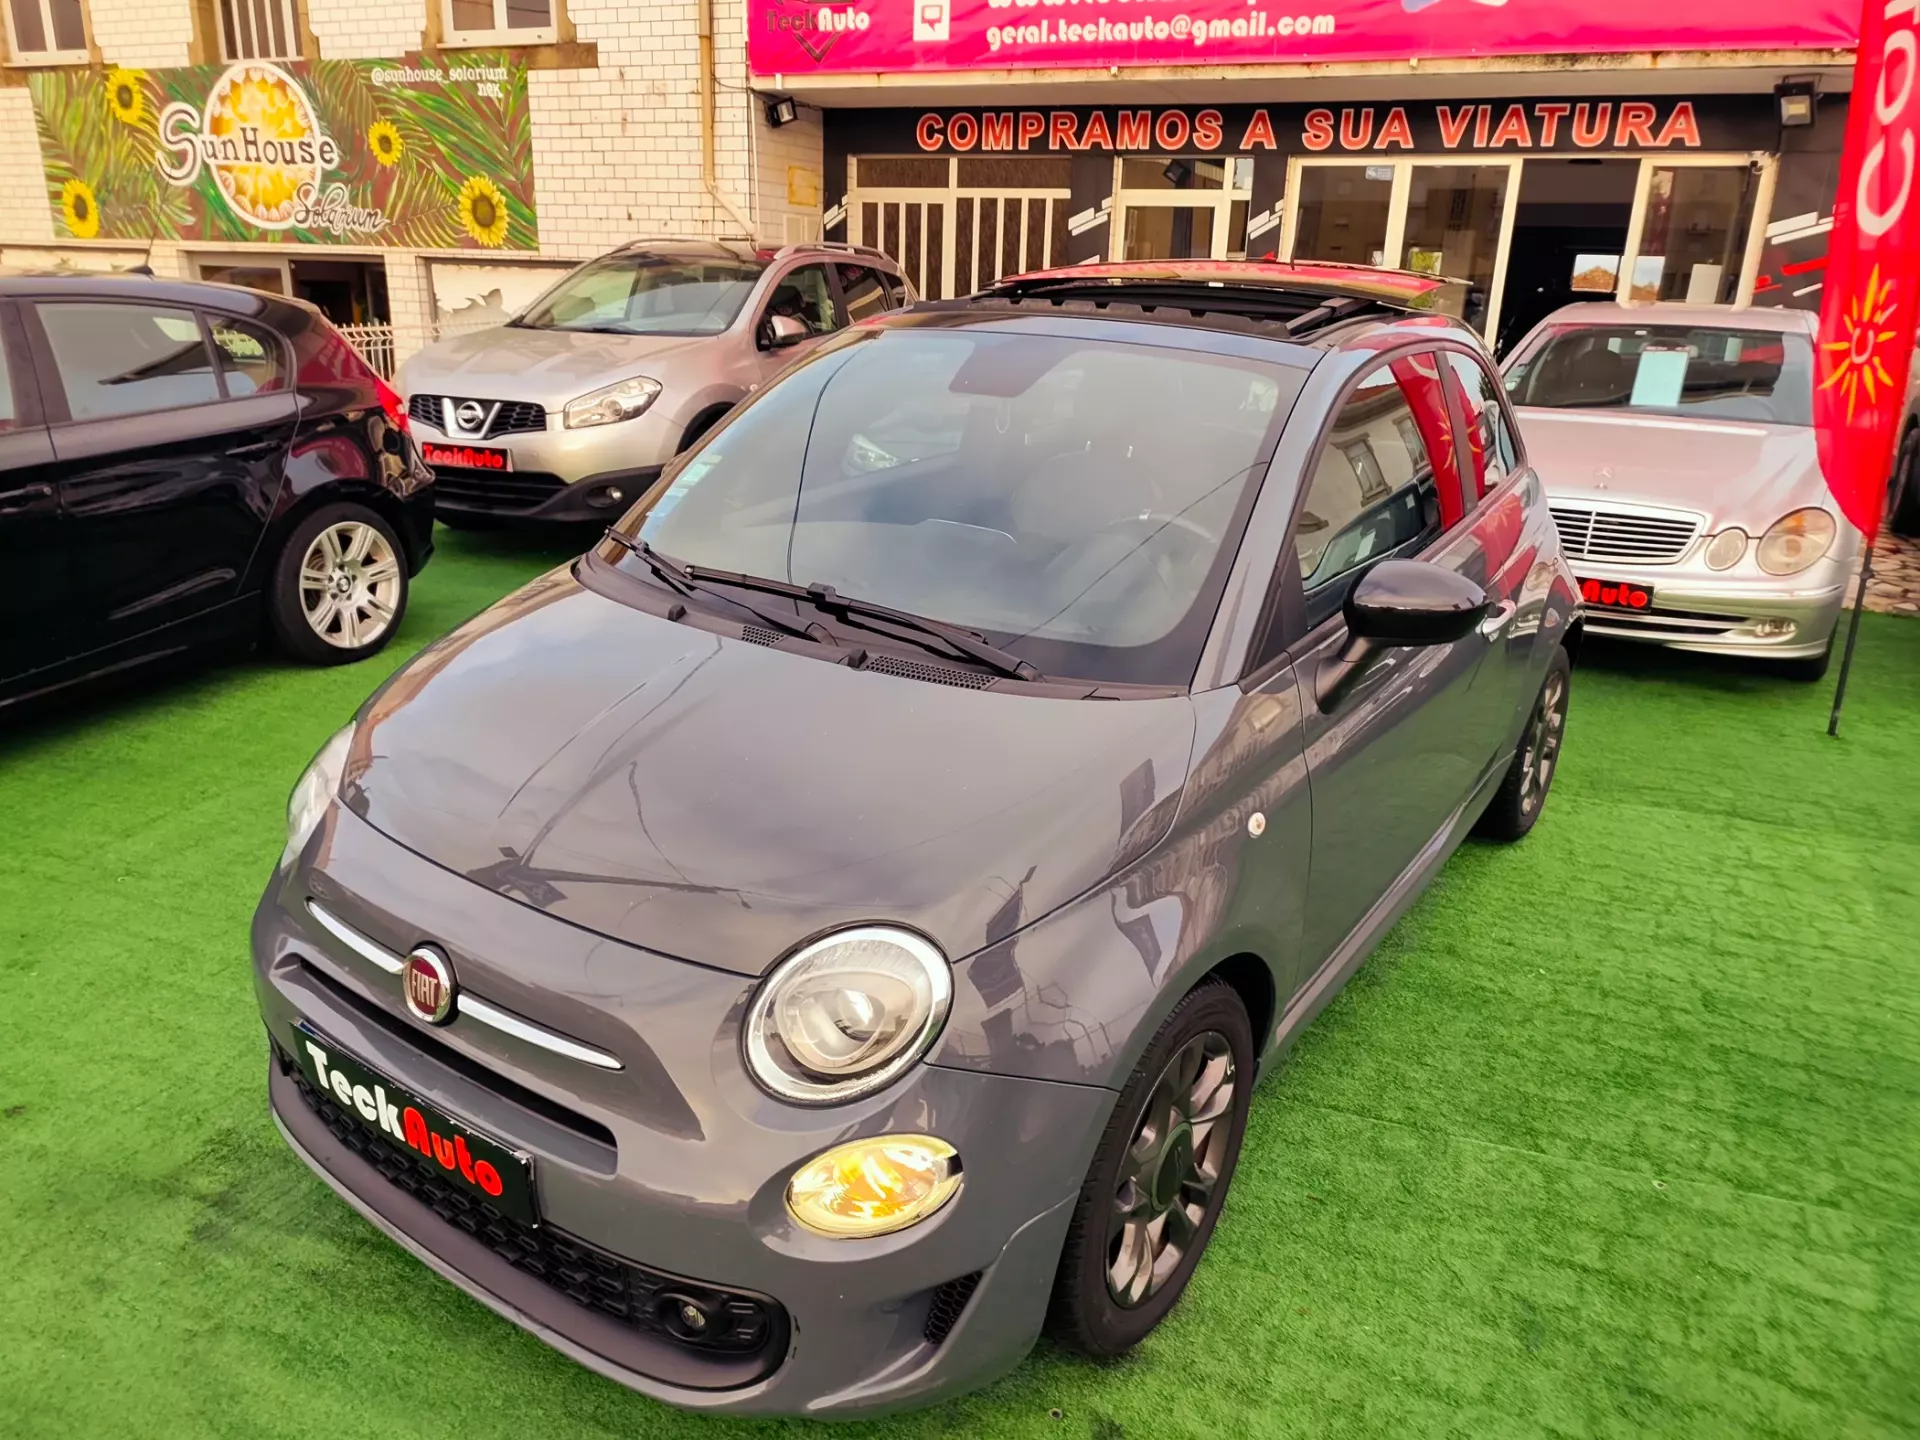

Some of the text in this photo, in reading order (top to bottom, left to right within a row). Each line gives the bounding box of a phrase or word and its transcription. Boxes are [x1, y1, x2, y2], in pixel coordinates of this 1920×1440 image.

[766, 7, 870, 32] TeckAuto
[986, 12, 1335, 50] geral.teckauto@gmail.com
[371, 64, 508, 86] @sunhouse_solarium
[156, 101, 339, 186] SunHouse
[915, 101, 1701, 151] COMPRAMOS A SUA VIATURA
[293, 181, 390, 235] Solarium
[423, 445, 503, 468] TeckAuto
[1580, 580, 1648, 608] Auto
[410, 968, 438, 1007] FIAT
[305, 1040, 503, 1196] TeckAuto
